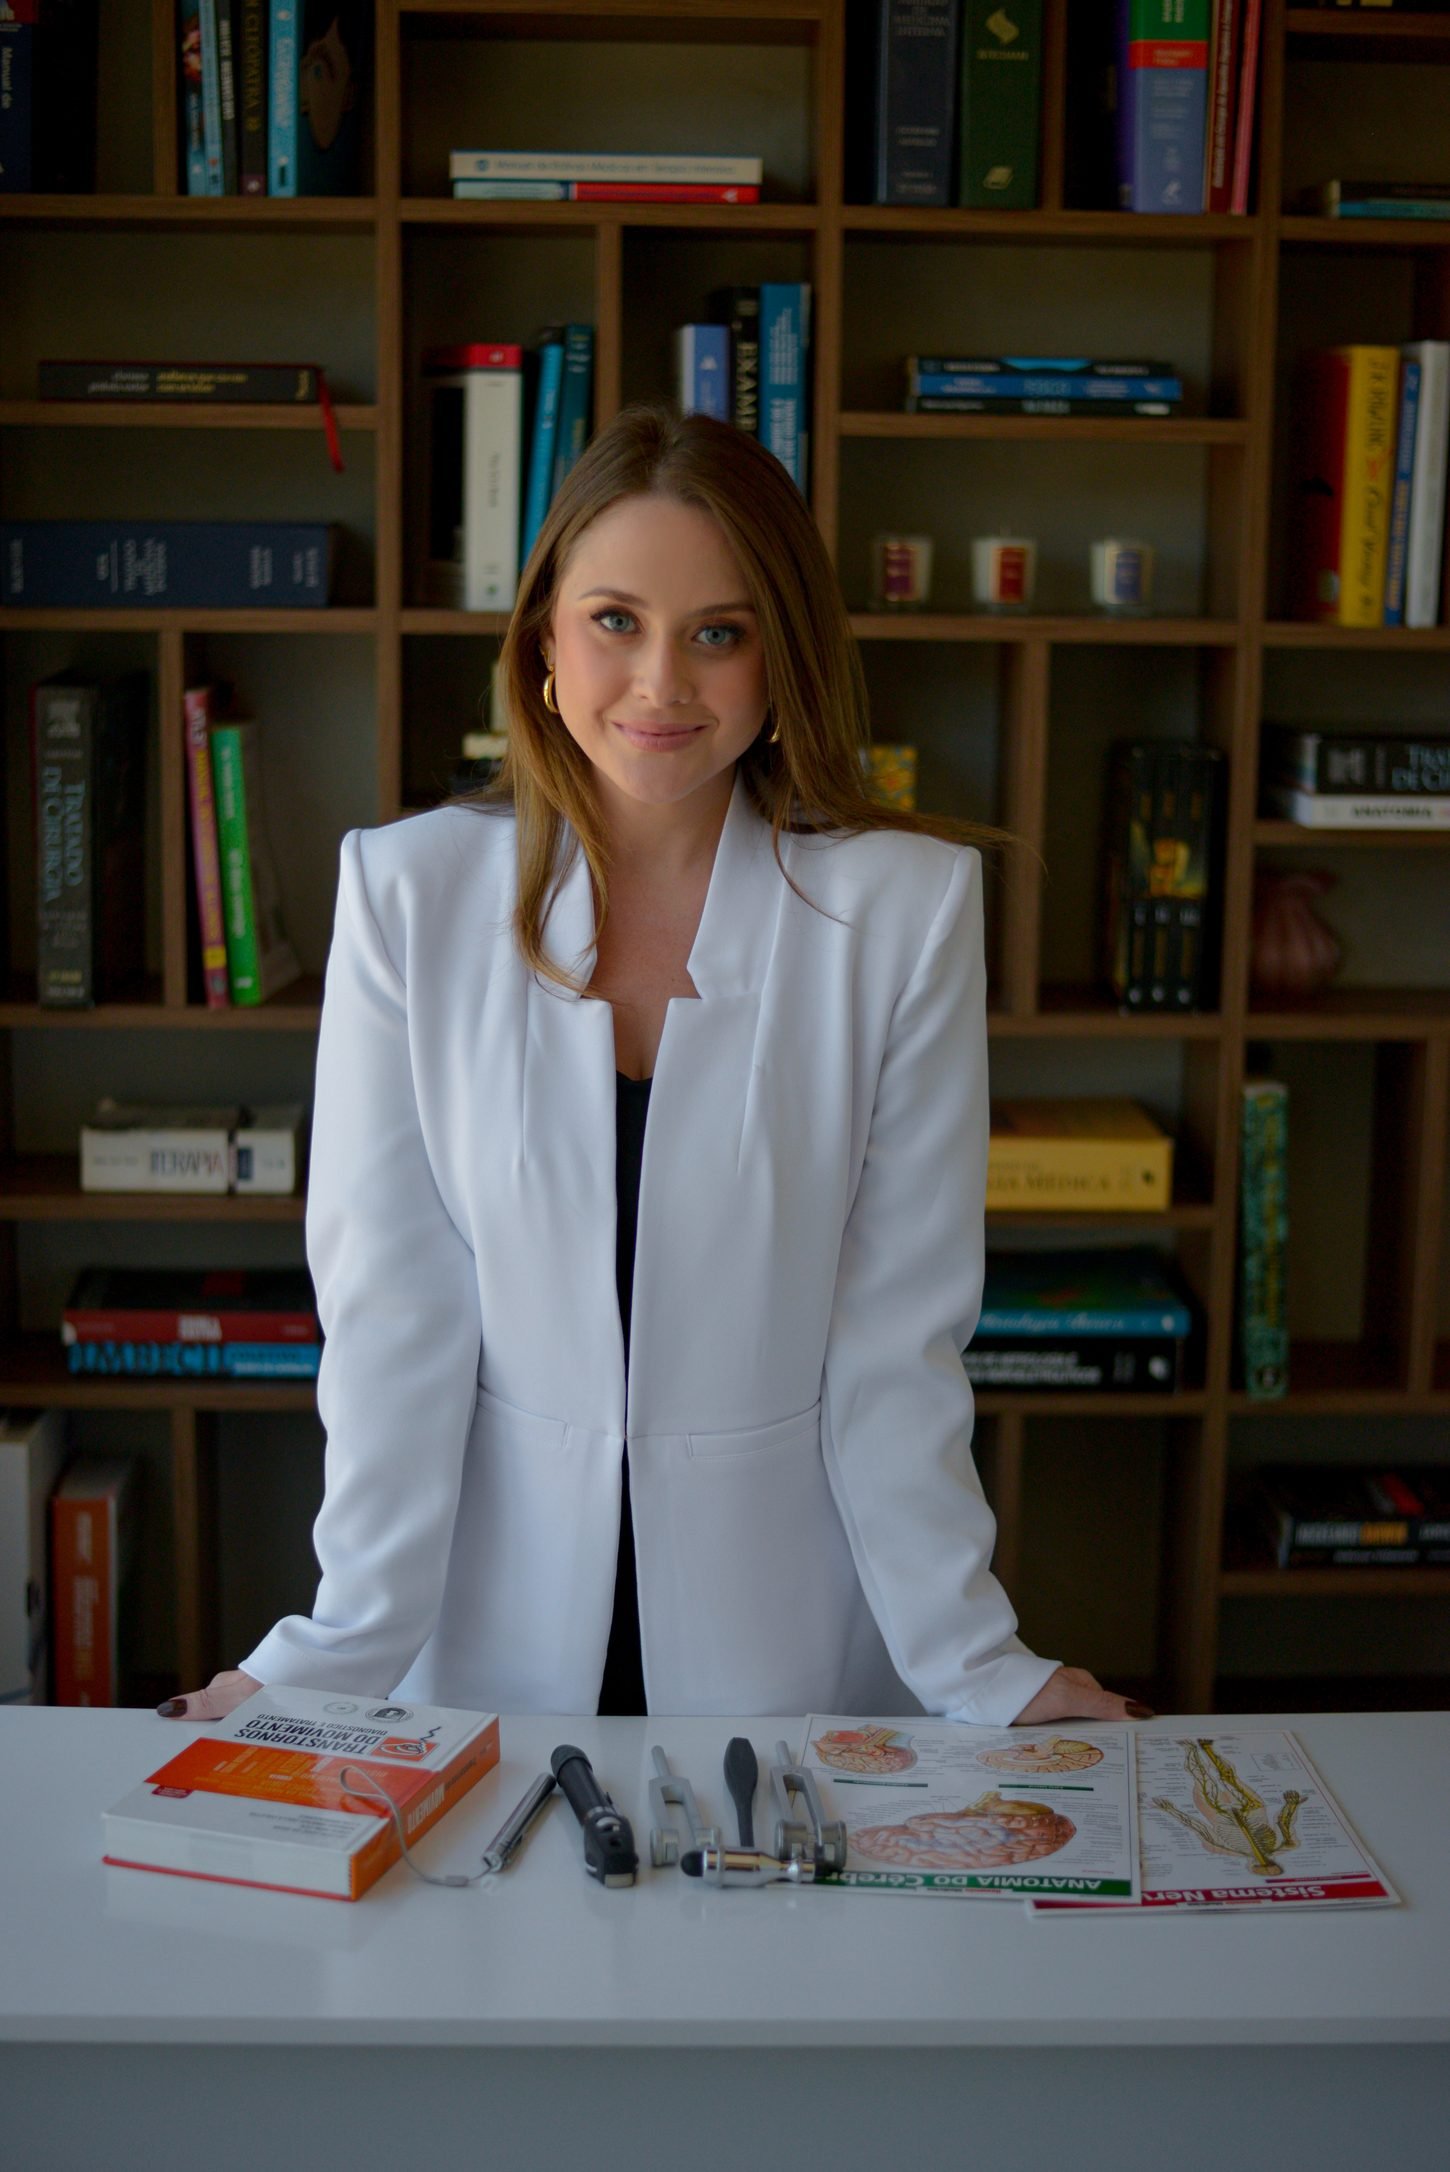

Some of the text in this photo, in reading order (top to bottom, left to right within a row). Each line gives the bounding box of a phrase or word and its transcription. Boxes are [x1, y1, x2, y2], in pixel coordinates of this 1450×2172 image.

[1, 92, 13, 109] de
[257, 1713, 319, 1727] TRATAMENTO
[245, 1720, 382, 1745] DO MOVIMENTO
[234, 1729, 370, 1755] TRANSTORNOS
[933, 1874, 969, 1888] DO
[977, 1876, 1102, 1891] ANATOMIA
[1210, 1884, 1326, 1904] Sistema
